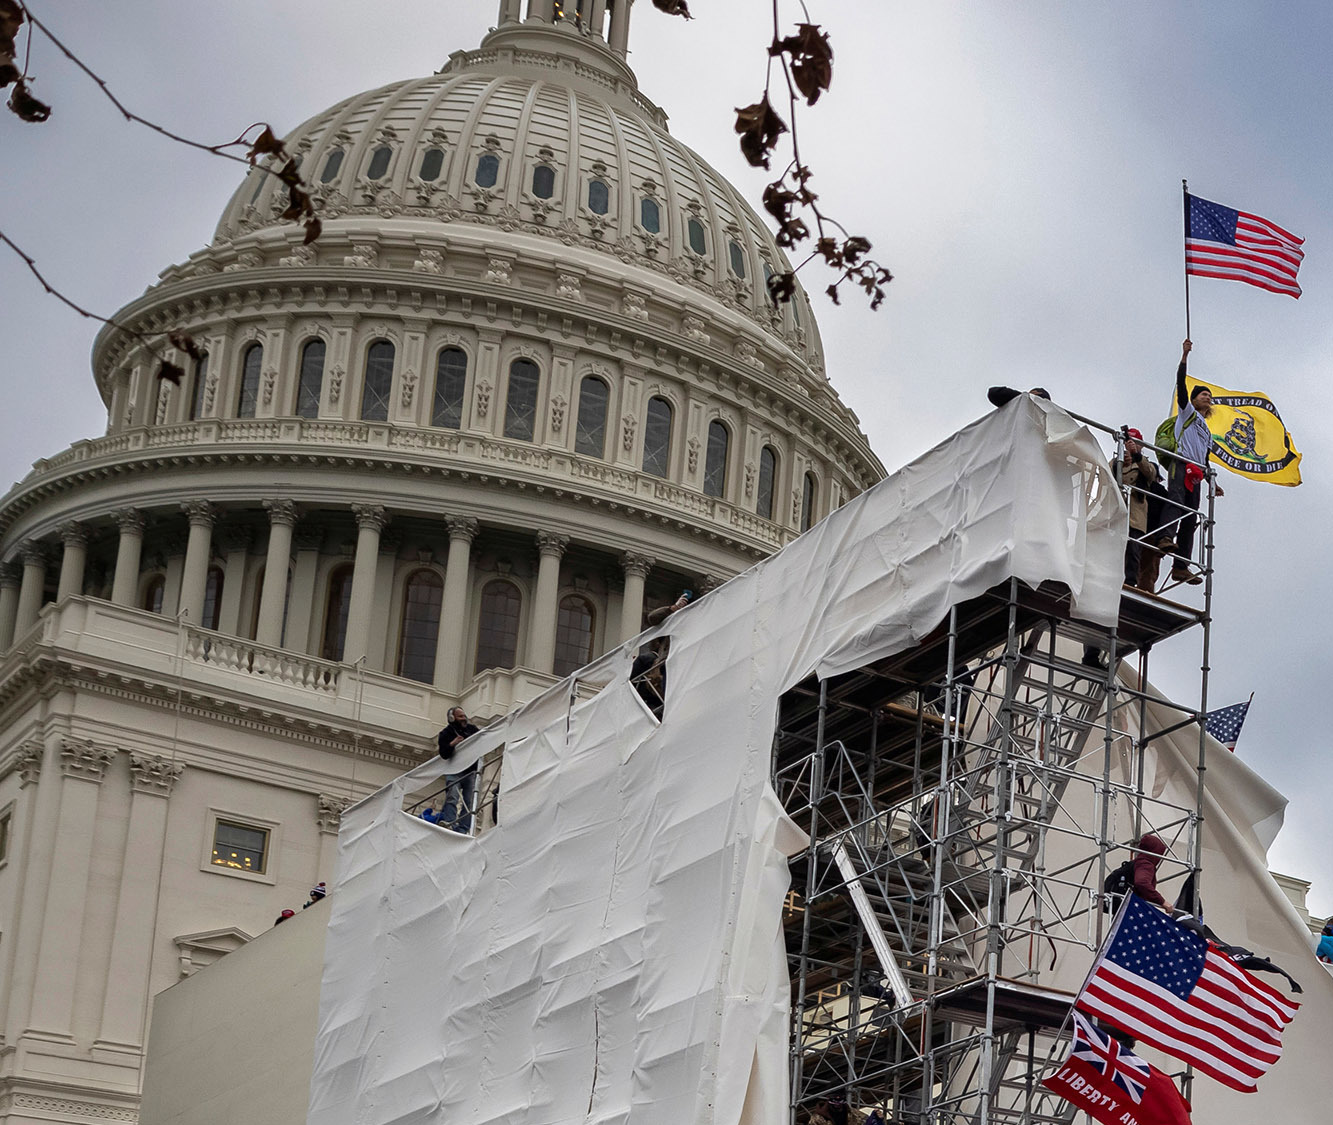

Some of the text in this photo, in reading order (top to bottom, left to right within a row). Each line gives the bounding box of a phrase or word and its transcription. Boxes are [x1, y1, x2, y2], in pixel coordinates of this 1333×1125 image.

[1226, 398, 1262, 406] TREAD
[1215, 448, 1283, 473] FREE OR DIE
[1057, 1068, 1121, 1112] LIBERTY
